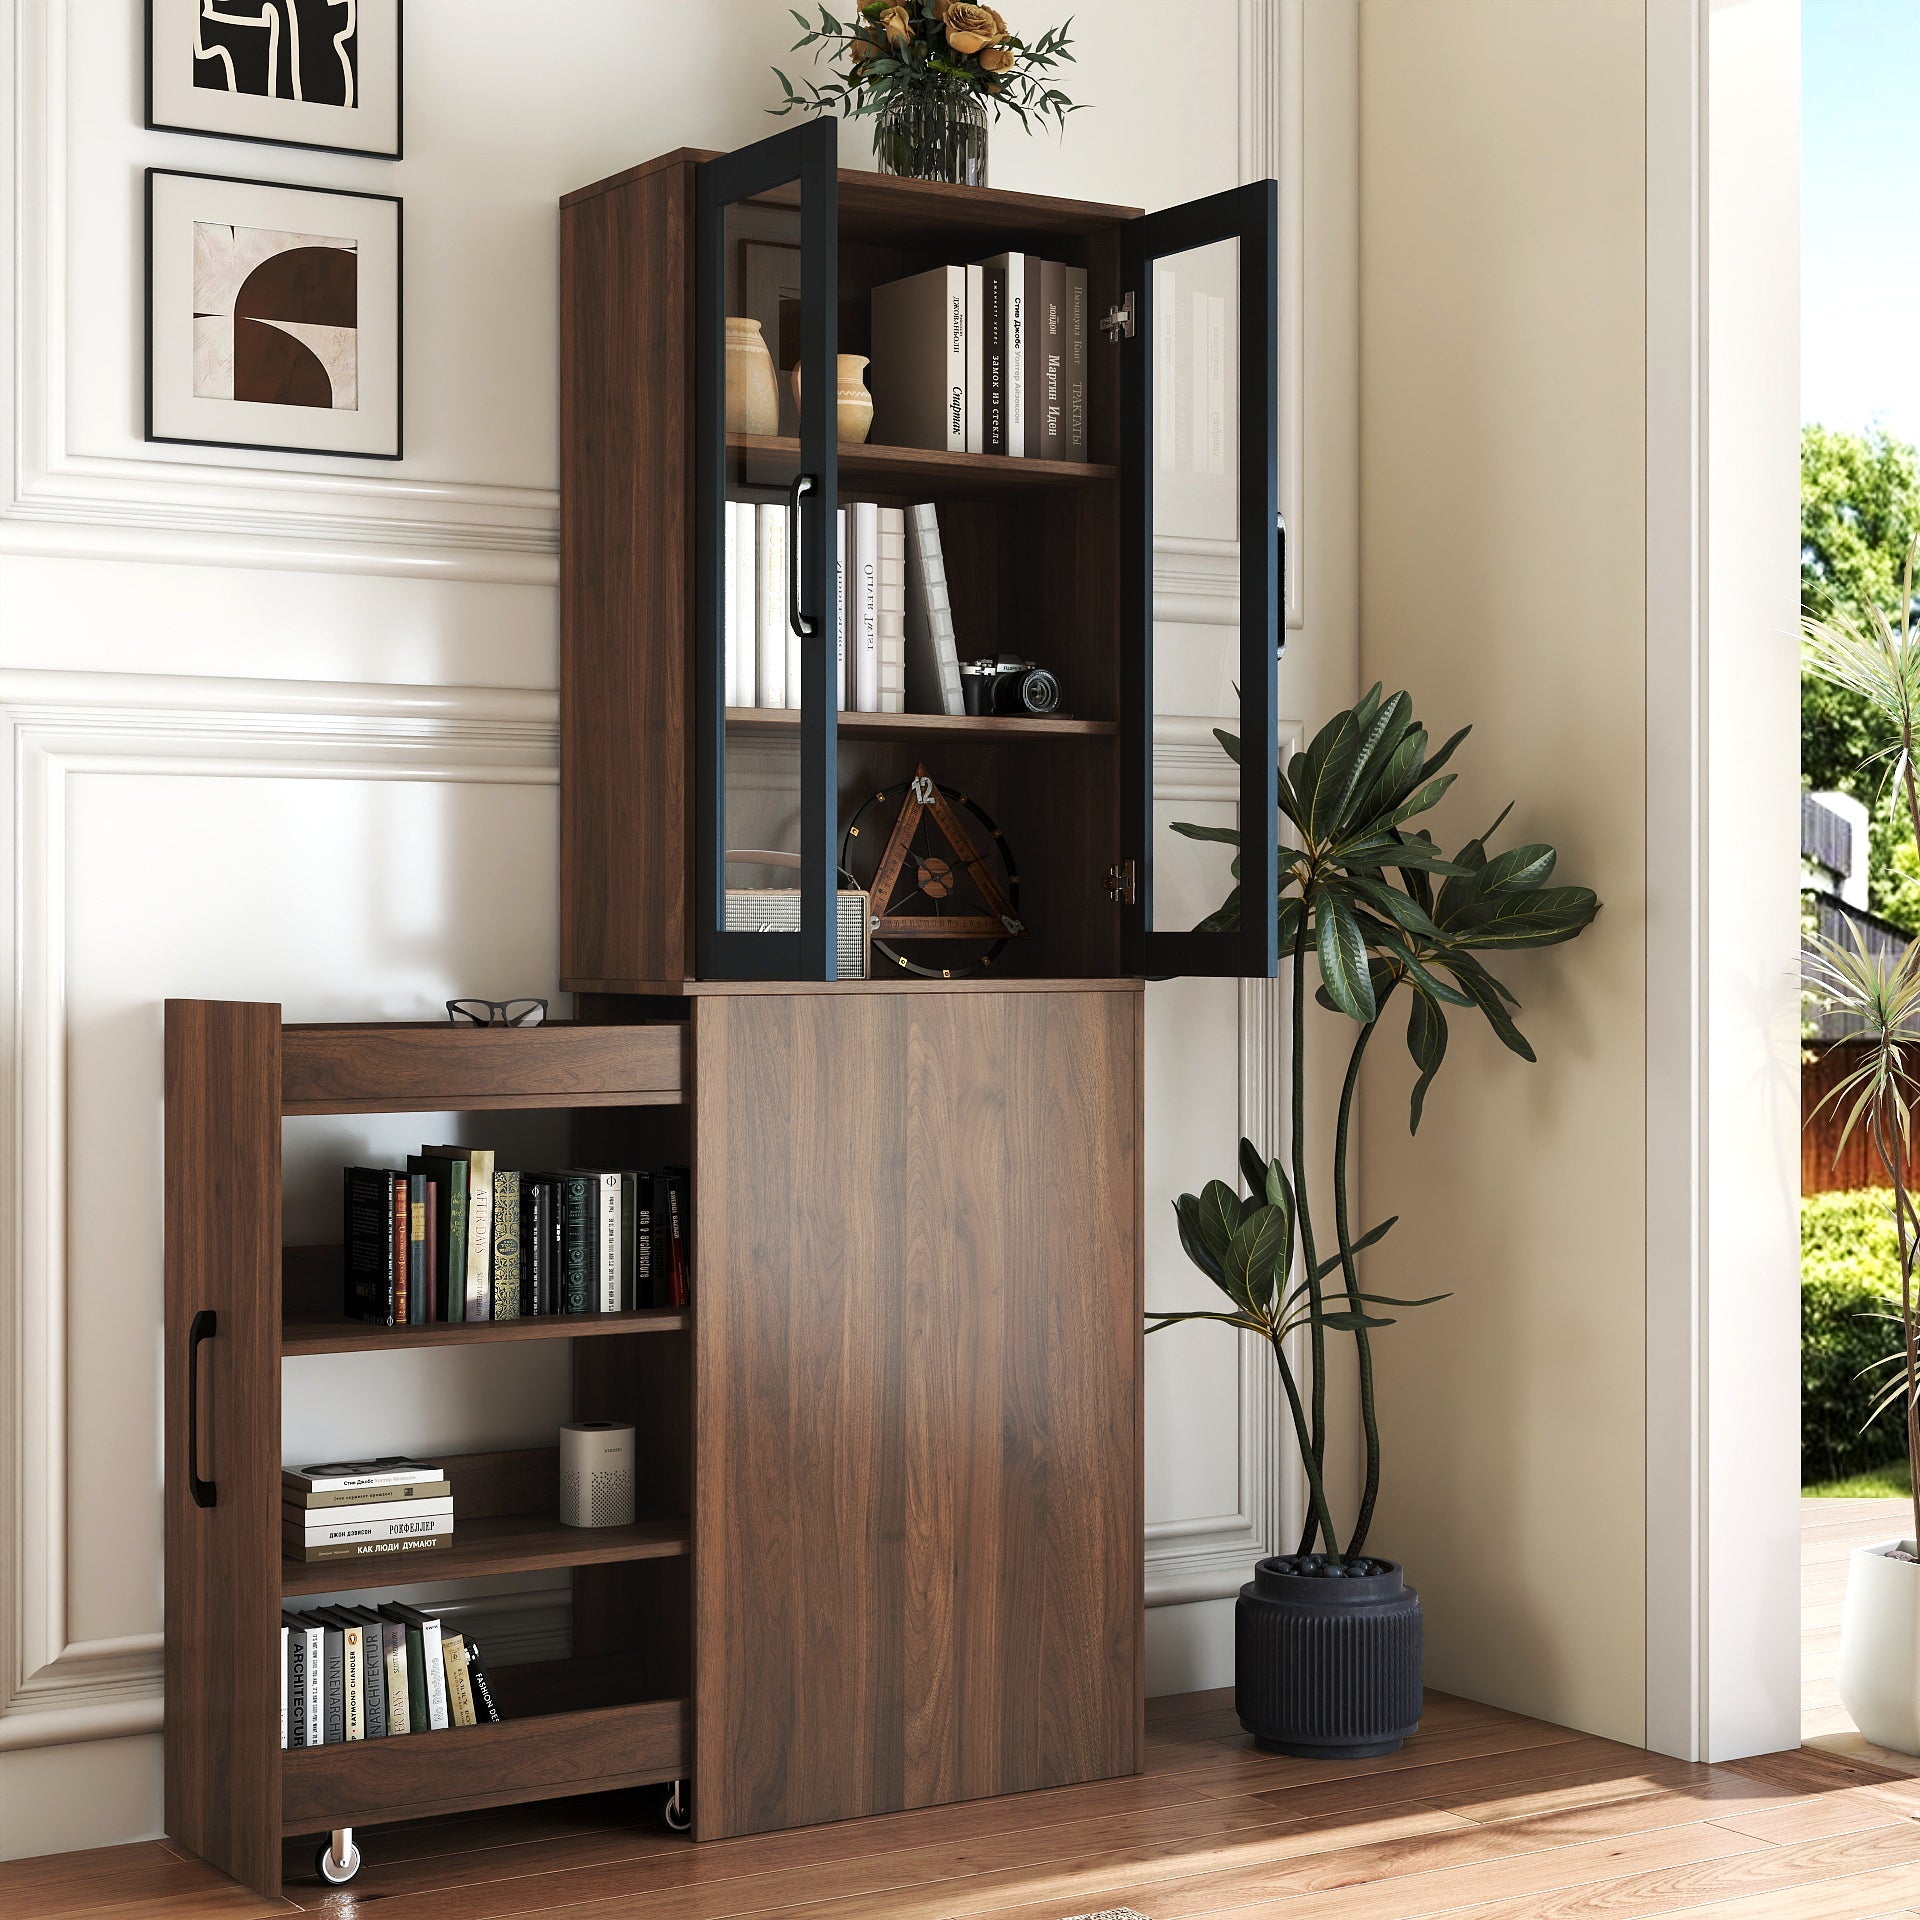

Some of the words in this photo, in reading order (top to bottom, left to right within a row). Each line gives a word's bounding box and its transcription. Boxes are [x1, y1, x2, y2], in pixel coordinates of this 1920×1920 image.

[1072, 286, 1083, 336] Иммануил
[1013, 319, 1022, 349] Джобс
[1013, 350, 1021, 381] Уолтер
[1073, 340, 1083, 365] Кант
[992, 355, 1000, 388] замок
[1046, 354, 1060, 401] Мартин
[950, 386, 963, 435] Спартак
[992, 392, 1000, 405] из
[1072, 381, 1082, 446] ТРАКТАТЫ
[992, 408, 1000, 445] стекла
[1047, 405, 1060, 436] Иден
[911, 776, 936, 804] 12
[475, 1188, 488, 1223] AFTER
[639, 1210, 651, 1225] arts
[474, 1226, 487, 1254] DAYS
[639, 1235, 651, 1278] architecture
[329, 1531, 346, 1539] ДЖОН
[389, 1521, 435, 1535] РОКФЕЛЛЕР
[357, 1546, 374, 1554] КАК
[375, 1543, 400, 1553] ЛЮДИ
[402, 1539, 437, 1551] ДУМАЮТ
[293, 1643, 304, 1747] ARCHITECTUR
[393, 1690, 404, 1717] DAYS
[476, 1672, 494, 1708] FASHION
